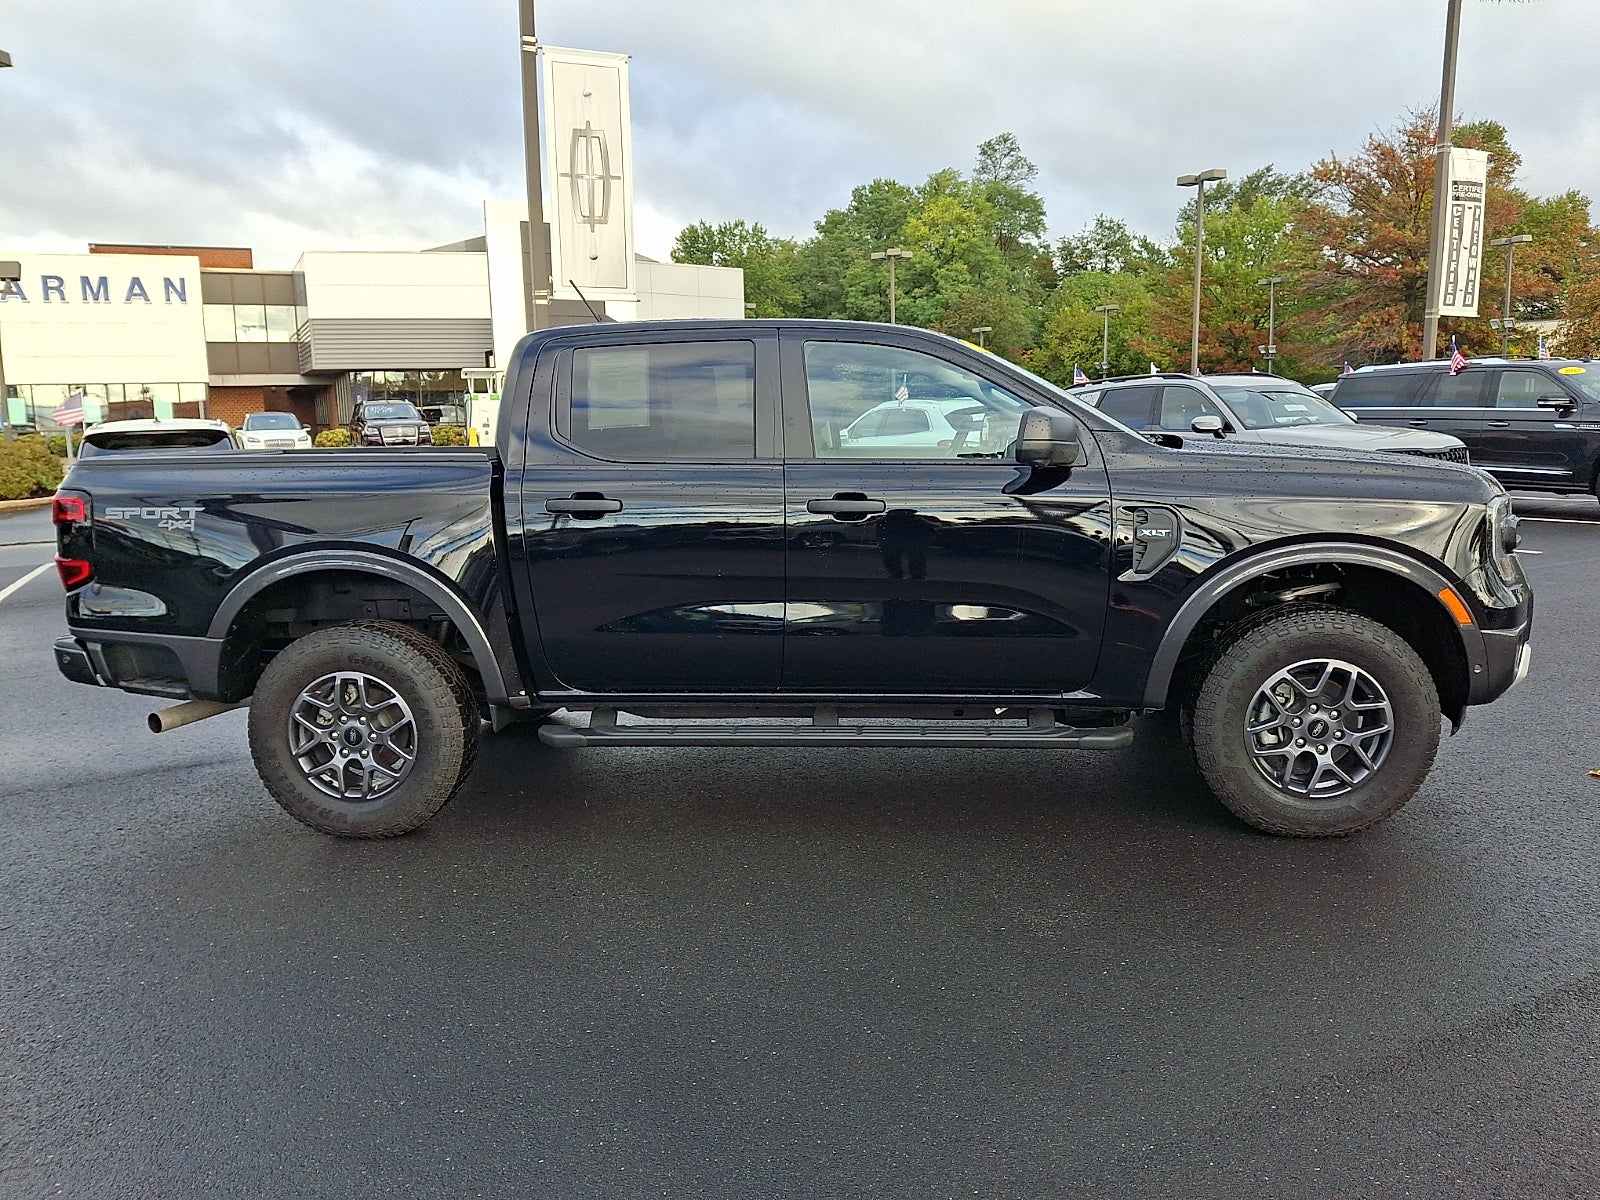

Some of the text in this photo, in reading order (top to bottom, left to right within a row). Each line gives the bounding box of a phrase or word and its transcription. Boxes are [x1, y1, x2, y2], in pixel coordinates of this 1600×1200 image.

[1445, 206, 1462, 305] CERTIFIED
[104, 506, 206, 520] SPORT
[1140, 528, 1172, 538] XLT
